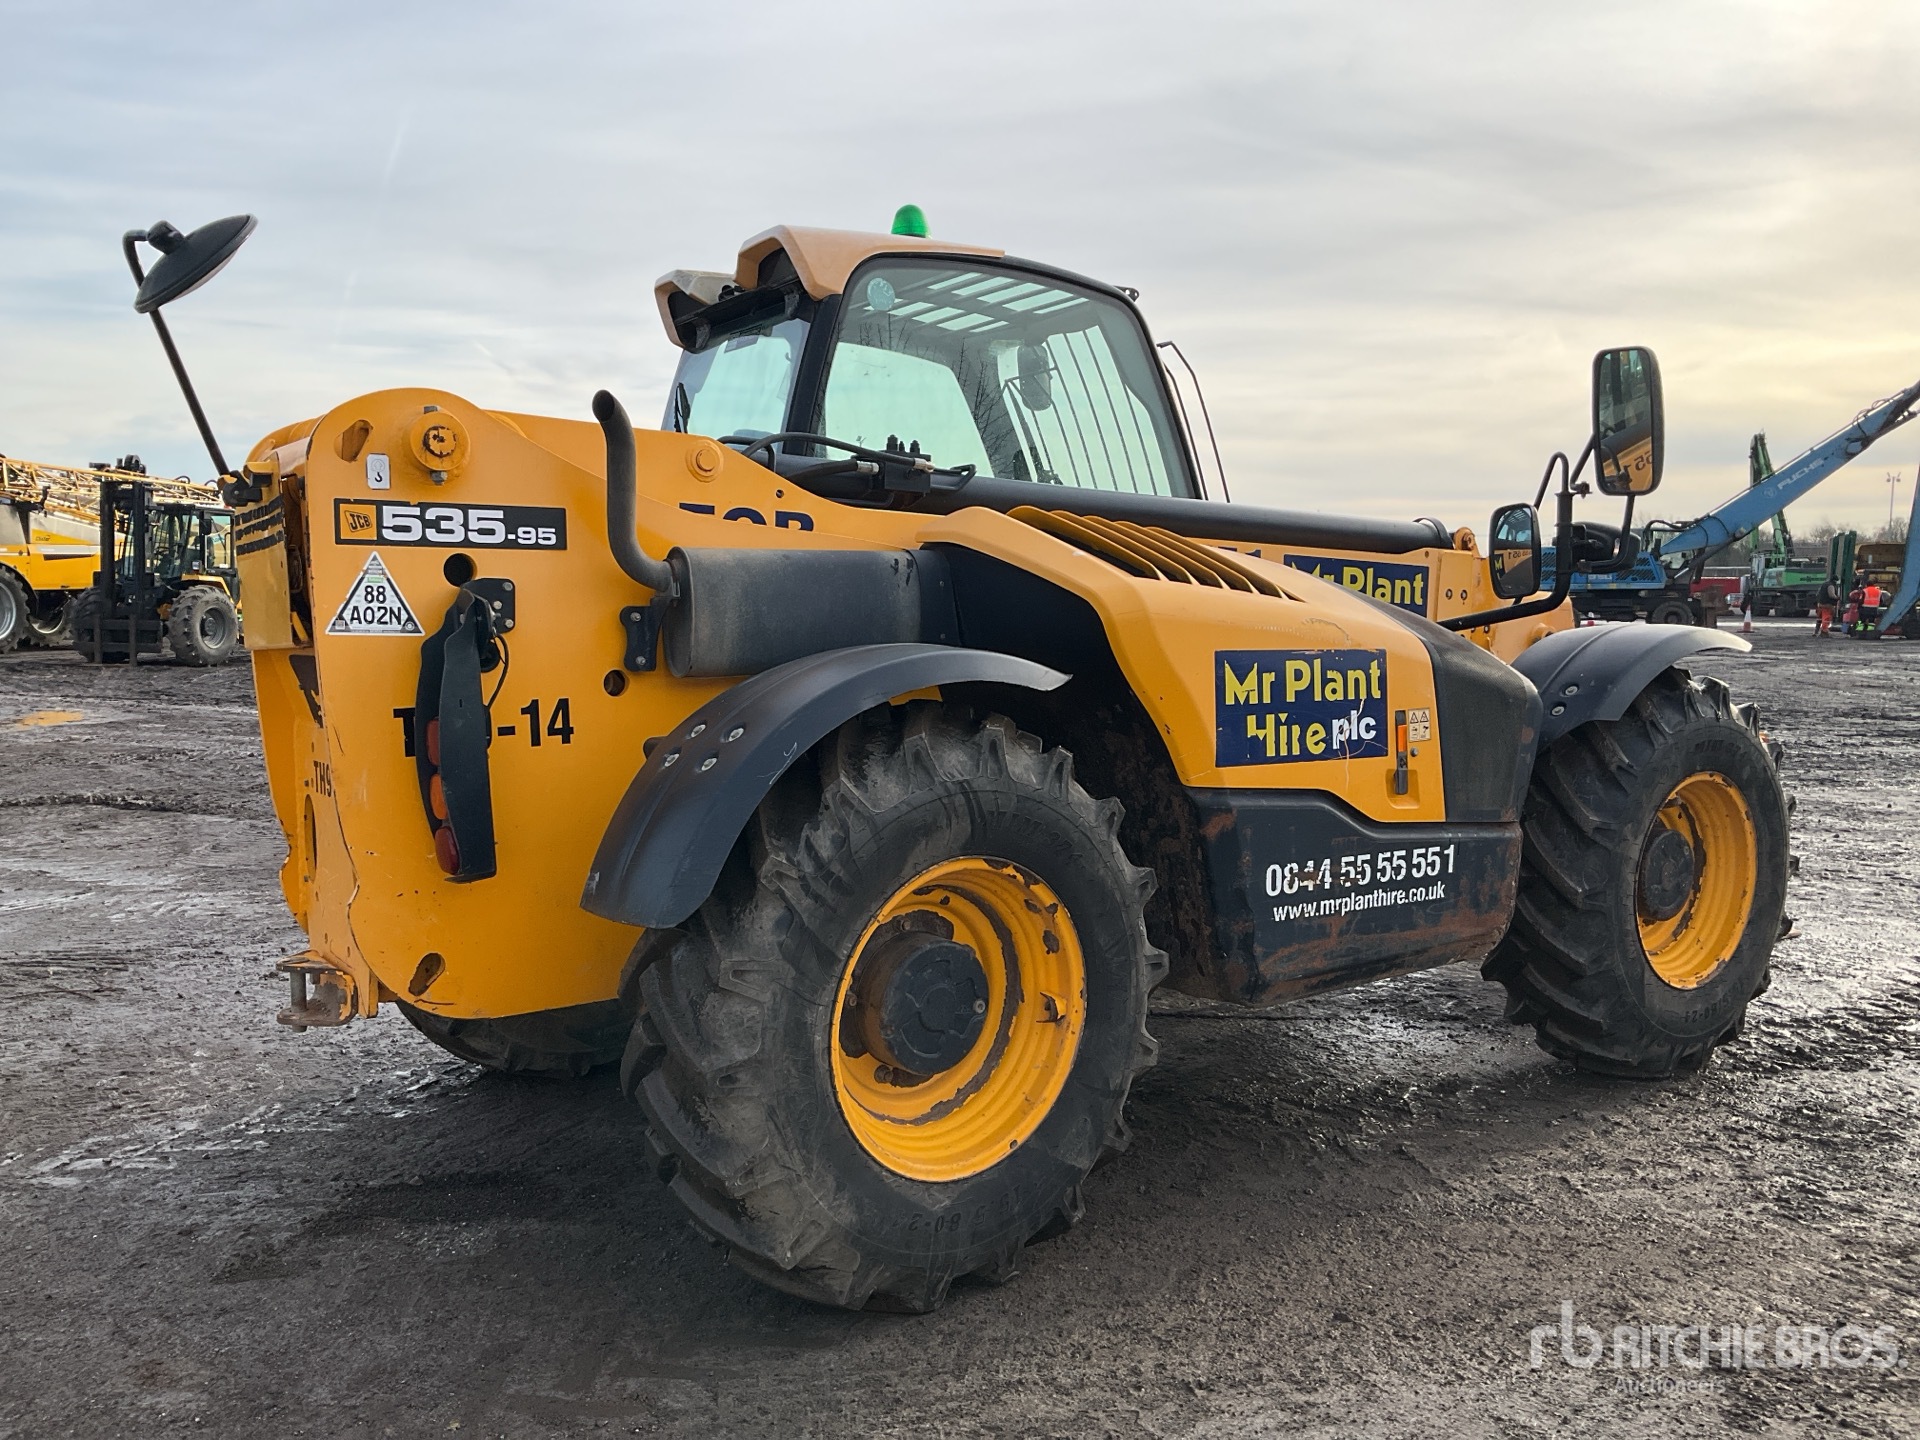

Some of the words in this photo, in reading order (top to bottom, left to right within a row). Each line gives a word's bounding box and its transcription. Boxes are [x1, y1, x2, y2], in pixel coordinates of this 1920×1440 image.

[350, 512, 371, 531] JCB
[381, 505, 557, 546] 535-95
[364, 585, 387, 604] 88
[1343, 567, 1424, 606] Plant
[1225, 660, 1276, 705] Mr
[1285, 658, 1381, 702] Plant
[393, 698, 574, 757] T-14
[1247, 713, 1327, 757] Hire
[1332, 710, 1377, 749] plc
[1265, 858, 1332, 897] 0844
[1340, 854, 1371, 887] 55
[1376, 850, 1407, 882] 55
[1411, 845, 1455, 878] 551
[1273, 881, 1446, 922] www.mrplanthire.co.uk
